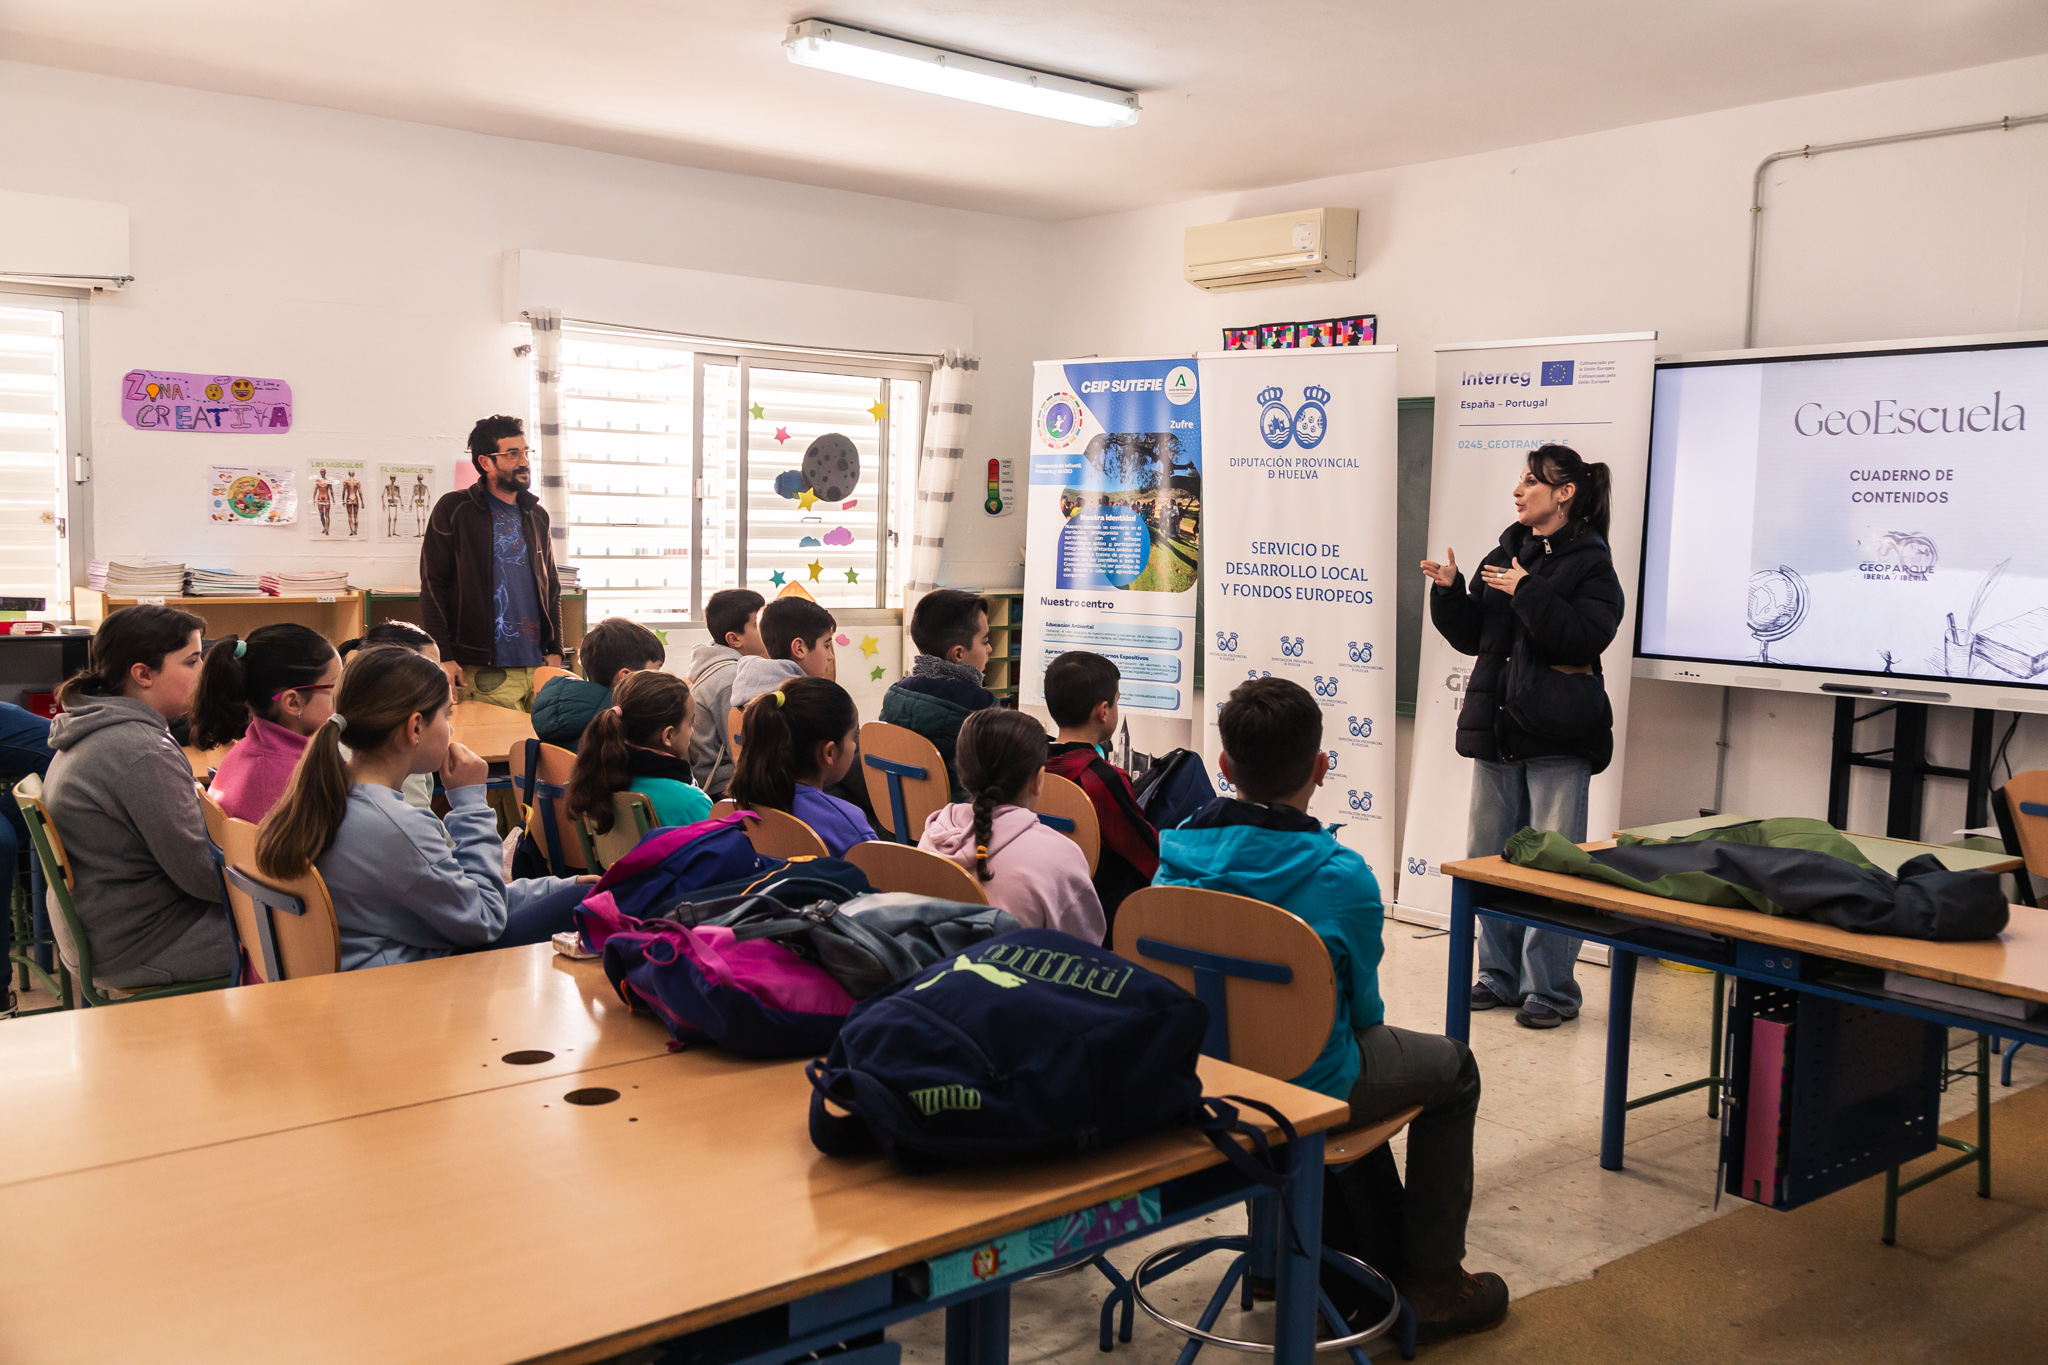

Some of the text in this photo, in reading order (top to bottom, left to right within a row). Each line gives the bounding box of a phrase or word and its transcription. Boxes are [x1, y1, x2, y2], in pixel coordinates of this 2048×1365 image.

[1462, 371, 1531, 387] Interreg
[1081, 378, 1164, 394] CEIP SUTEFIE
[1460, 400, 1495, 411] España
[1505, 398, 1548, 409] Portugal
[136, 404, 289, 429] CREATIVA
[1794, 390, 2026, 436] GeoEscuela
[1170, 419, 1194, 429] Zufre
[1229, 455, 1360, 468] DIPUTACIÓN PROVINCIAL
[1278, 470, 1319, 480] HUELVA
[1850, 469, 1954, 481] CUADERNO DE
[1851, 491, 1949, 503] CONTENIDOS
[1251, 541, 1340, 558] SERVICIO DE
[1226, 562, 1369, 582] DESARROLLO LOCAL
[1859, 563, 1935, 574] GEOPARQUE
[1220, 583, 1373, 605] Y FONDOS EUROPEOS
[1040, 596, 1114, 609] Nuestro centro
[1119, 653, 1149, 661] Expositivos
